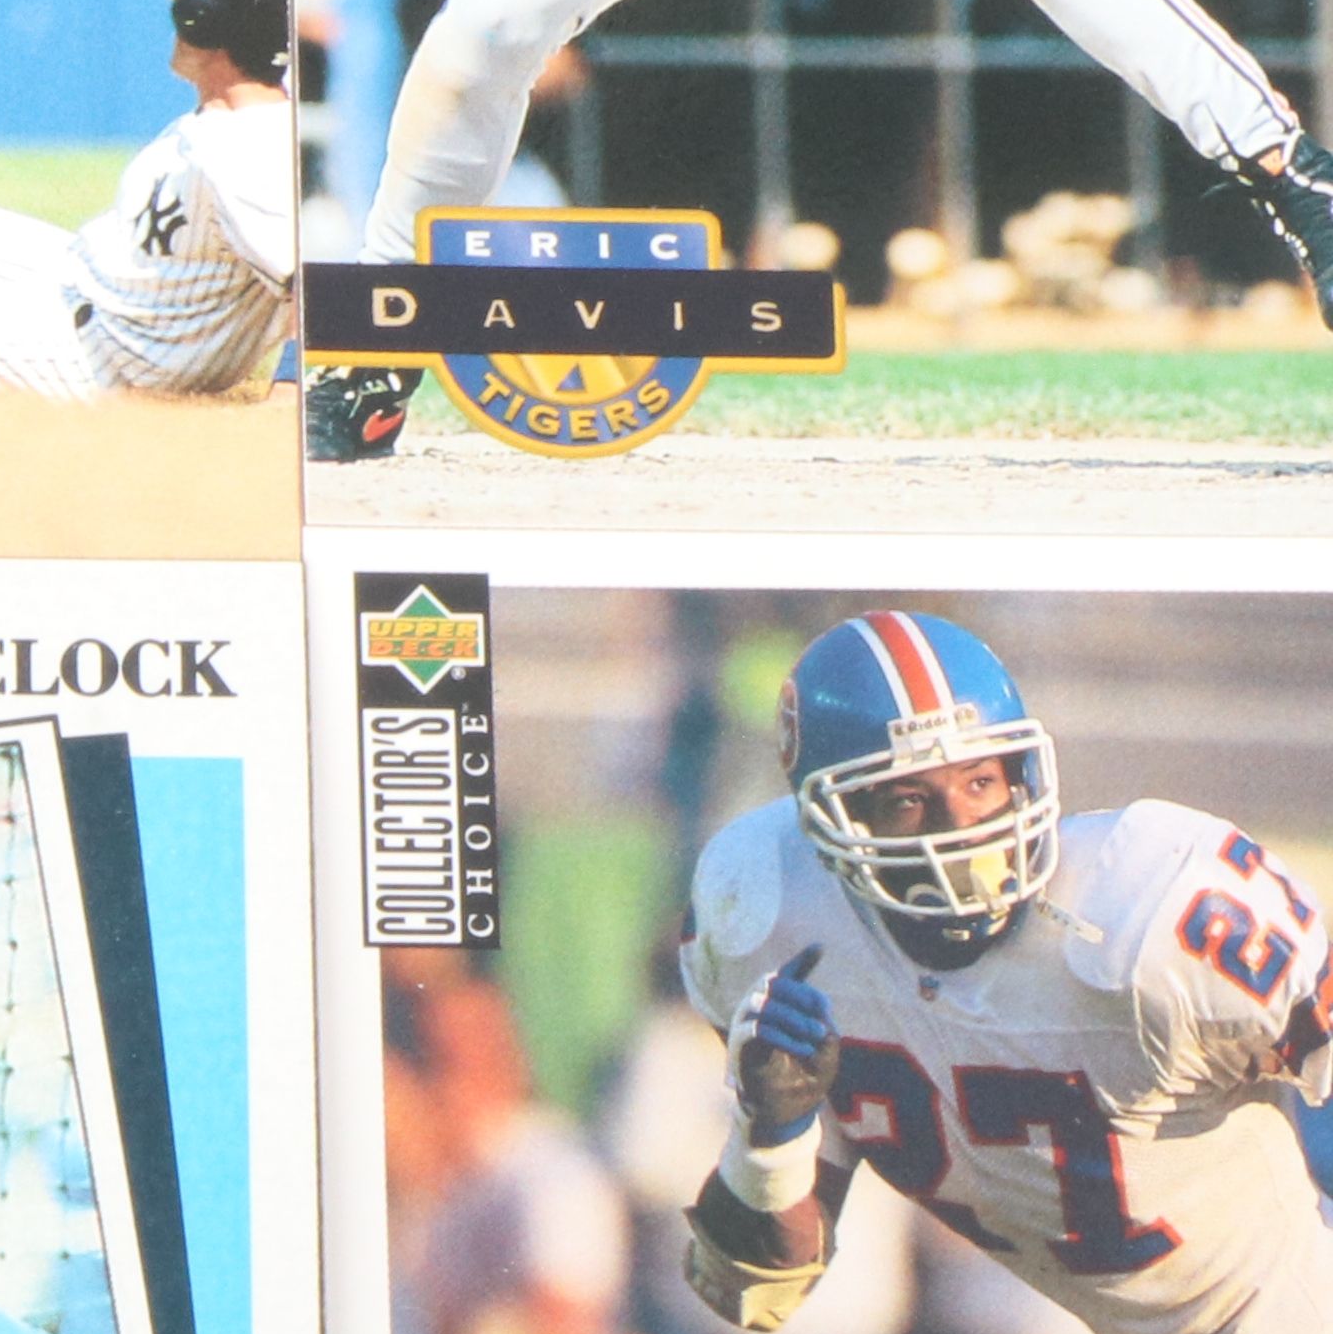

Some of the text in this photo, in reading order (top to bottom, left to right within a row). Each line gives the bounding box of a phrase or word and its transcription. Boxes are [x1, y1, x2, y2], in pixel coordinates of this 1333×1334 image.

[463, 229, 682, 260] ERIC
[370, 286, 783, 333] DAVIS
[478, 372, 673, 441] TIGERS
[368, 620, 479, 639] UPPER
[370, 715, 456, 937] COLLECTOR'S
[461, 713, 495, 939] CHOICE
